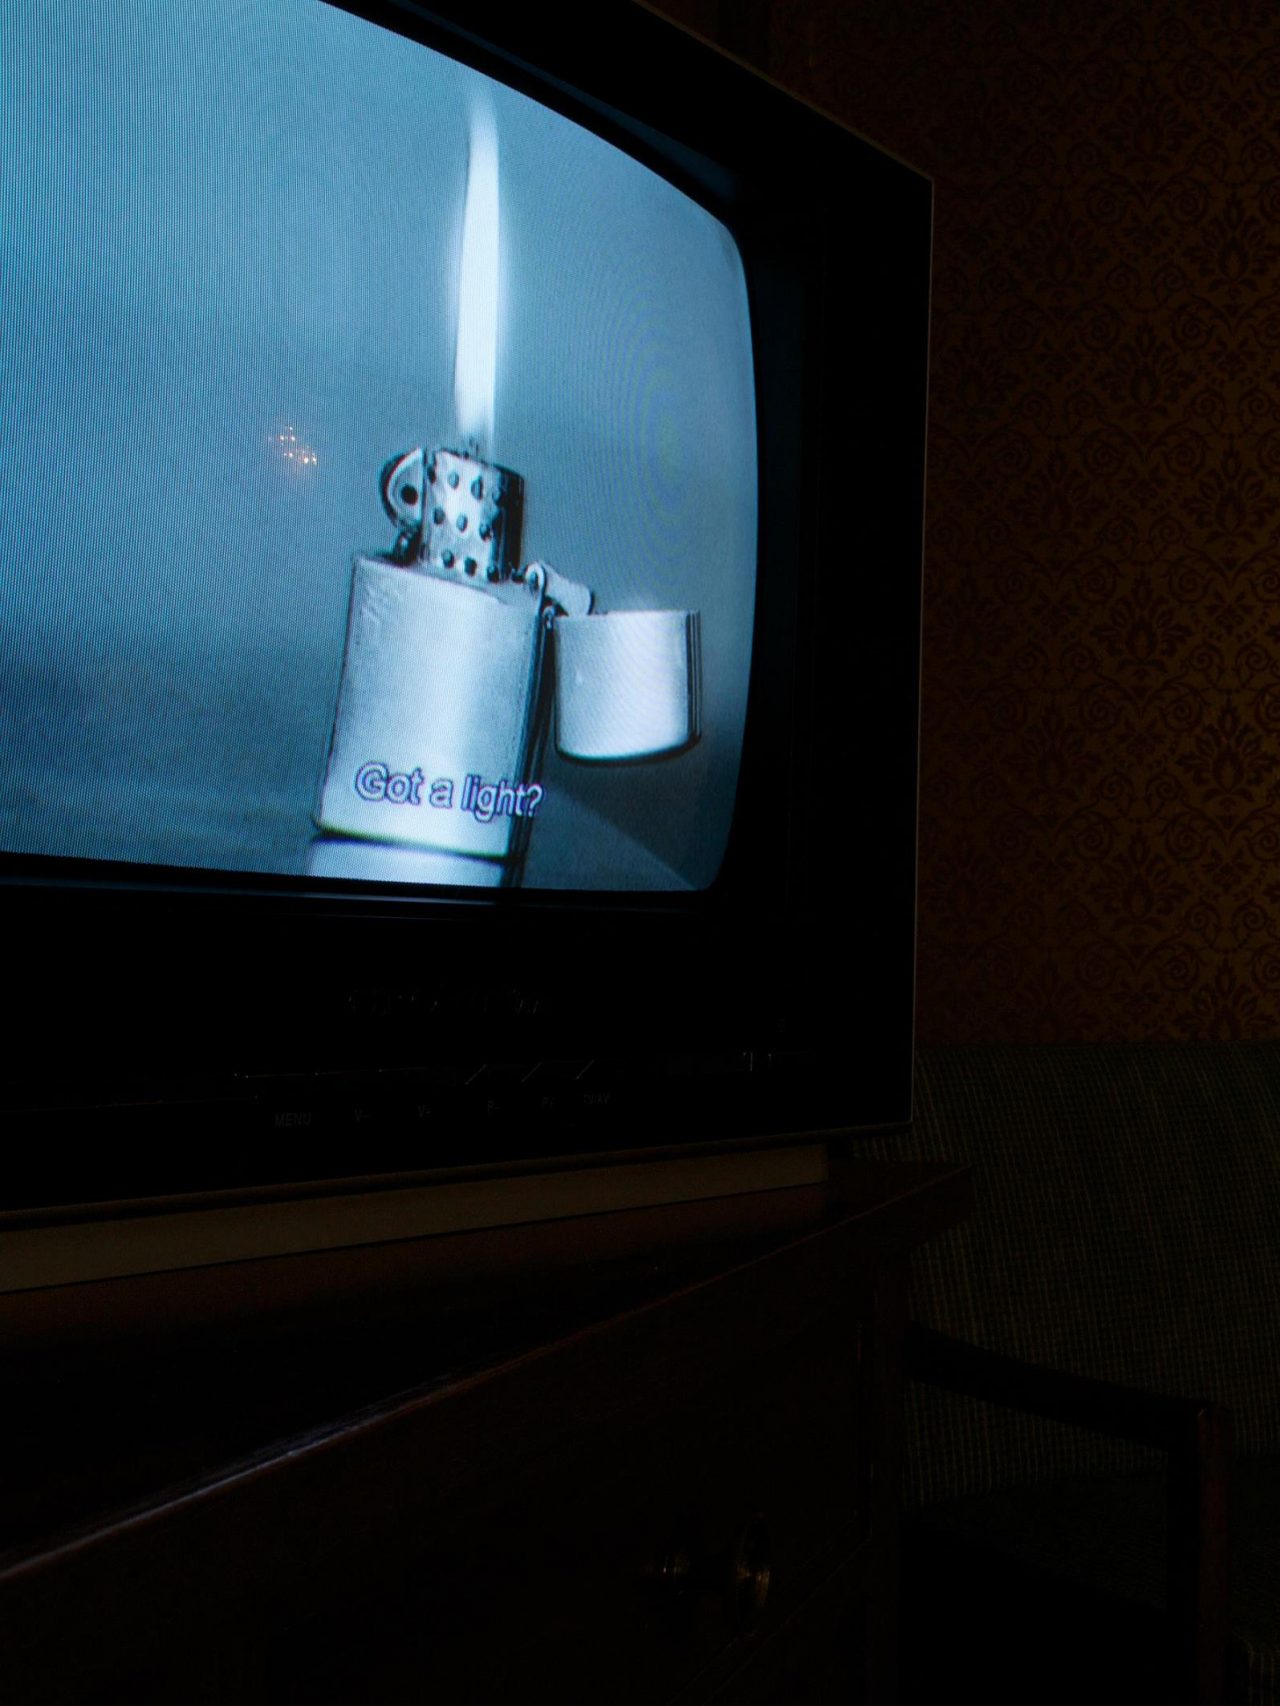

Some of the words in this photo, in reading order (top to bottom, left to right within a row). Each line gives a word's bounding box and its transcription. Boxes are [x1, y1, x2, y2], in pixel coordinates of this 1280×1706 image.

[355, 761, 424, 806] Got
[429, 777, 454, 809] a
[460, 773, 544, 823] light?
